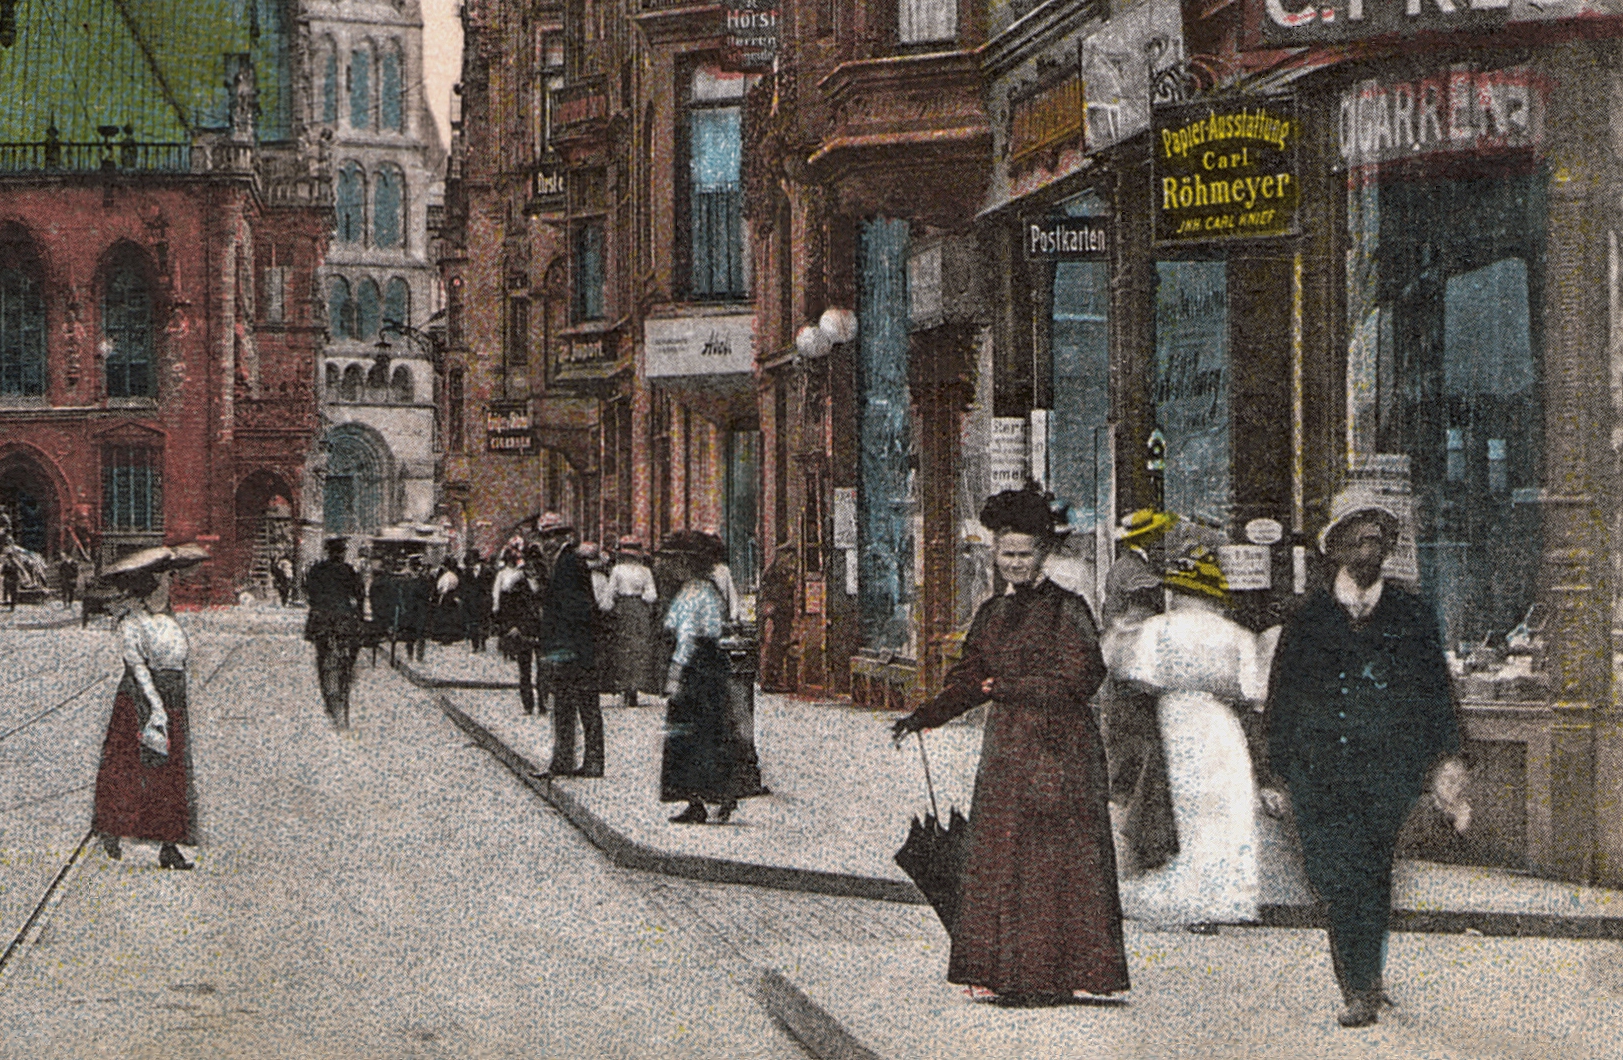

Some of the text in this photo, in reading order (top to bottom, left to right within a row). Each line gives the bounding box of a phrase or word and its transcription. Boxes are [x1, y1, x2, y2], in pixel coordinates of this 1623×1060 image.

[1202, 146, 1249, 171] Carl
[1162, 172, 1290, 210] Röhmeyer
[1030, 224, 1106, 254] Postkarten
